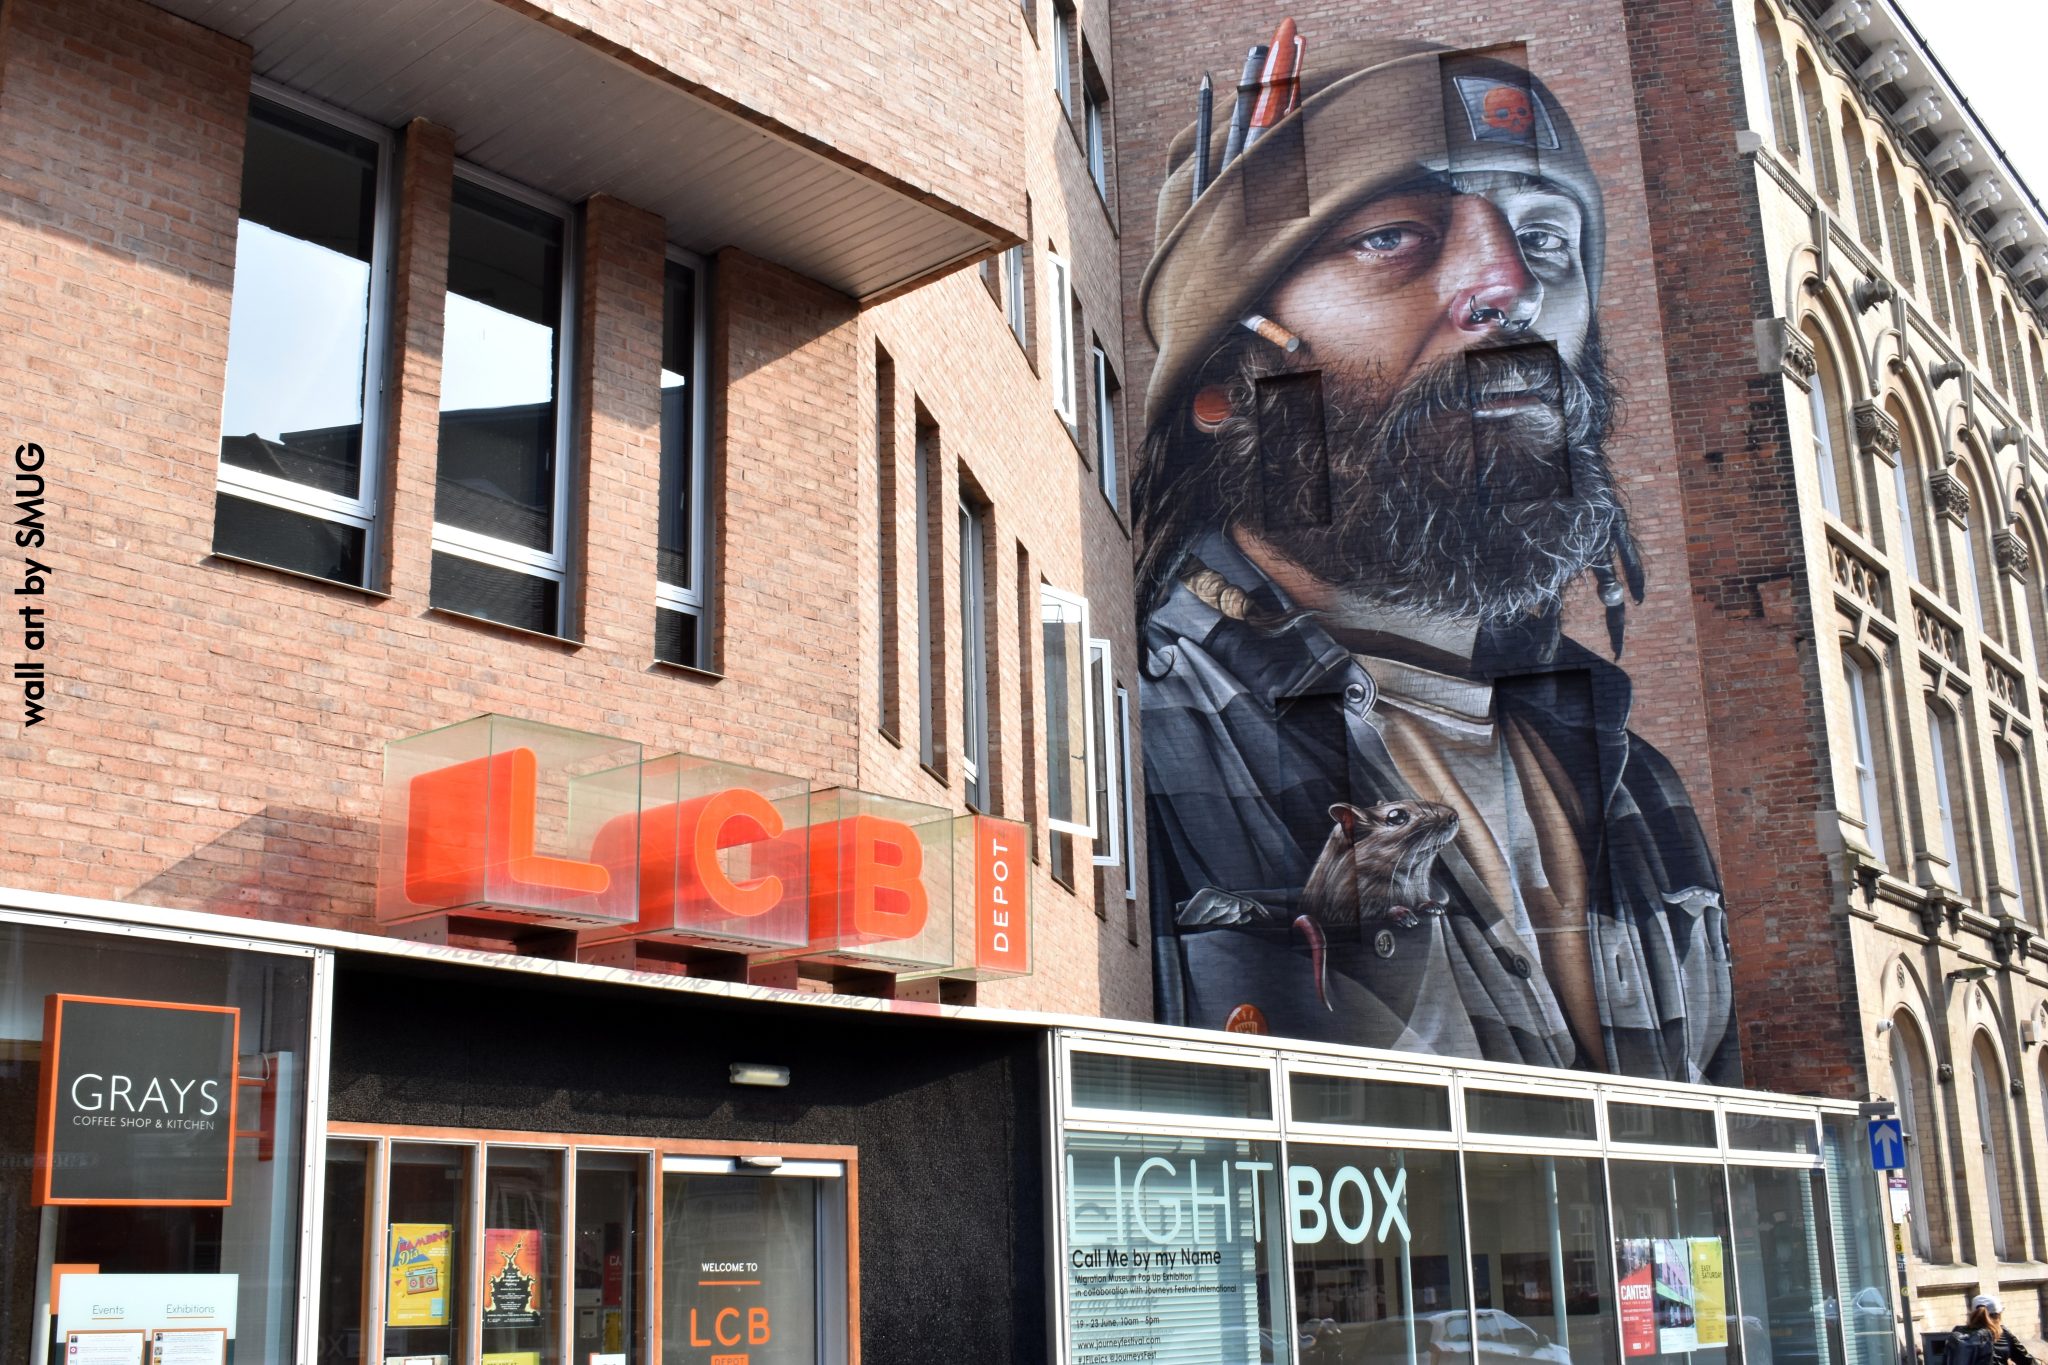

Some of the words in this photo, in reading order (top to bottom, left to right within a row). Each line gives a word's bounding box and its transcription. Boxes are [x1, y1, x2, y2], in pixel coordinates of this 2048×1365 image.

[507, 746, 930, 940] LCB
[992, 838, 1009, 953] DEPOT
[475, 905, 609, 925] Leicester
[71, 1073, 218, 1116] GRAYS
[73, 1115, 116, 1127] COFFEE
[120, 1117, 152, 1128] SHOP
[155, 1119, 163, 1129] &
[166, 1119, 215, 1131] KITCHEN
[1066, 1153, 1274, 1245] LIGHT
[1287, 1165, 1412, 1245] BOX
[701, 1262, 745, 1272] WELCOME
[746, 1262, 758, 1272] TO
[1072, 1248, 1102, 1268] Call
[1106, 1248, 1129, 1267] Me
[1133, 1248, 1151, 1271] by
[1155, 1251, 1177, 1270] my
[1181, 1247, 1222, 1265] Name
[1074, 1272, 1107, 1286] Migration
[1109, 1272, 1137, 1282] Museum
[1138, 1271, 1151, 1284] Pop
[1152, 1272, 1161, 1283] Up
[1162, 1271, 1193, 1281] Exhibition
[1075, 1287, 1082, 1297] in
[1083, 1285, 1128, 1297] collaboration
[1130, 1284, 1144, 1295] with
[1145, 1284, 1173, 1296] Journeys
[1174, 1283, 1198, 1294] Festival
[1198, 1282, 1237, 1293] International
[1620, 1284, 1652, 1301] CANTEEN
[92, 1304, 125, 1315] Events
[166, 1303, 216, 1314] Exhibitions
[690, 1306, 771, 1347] LCB
[1090, 1318, 1099, 1328] 23
